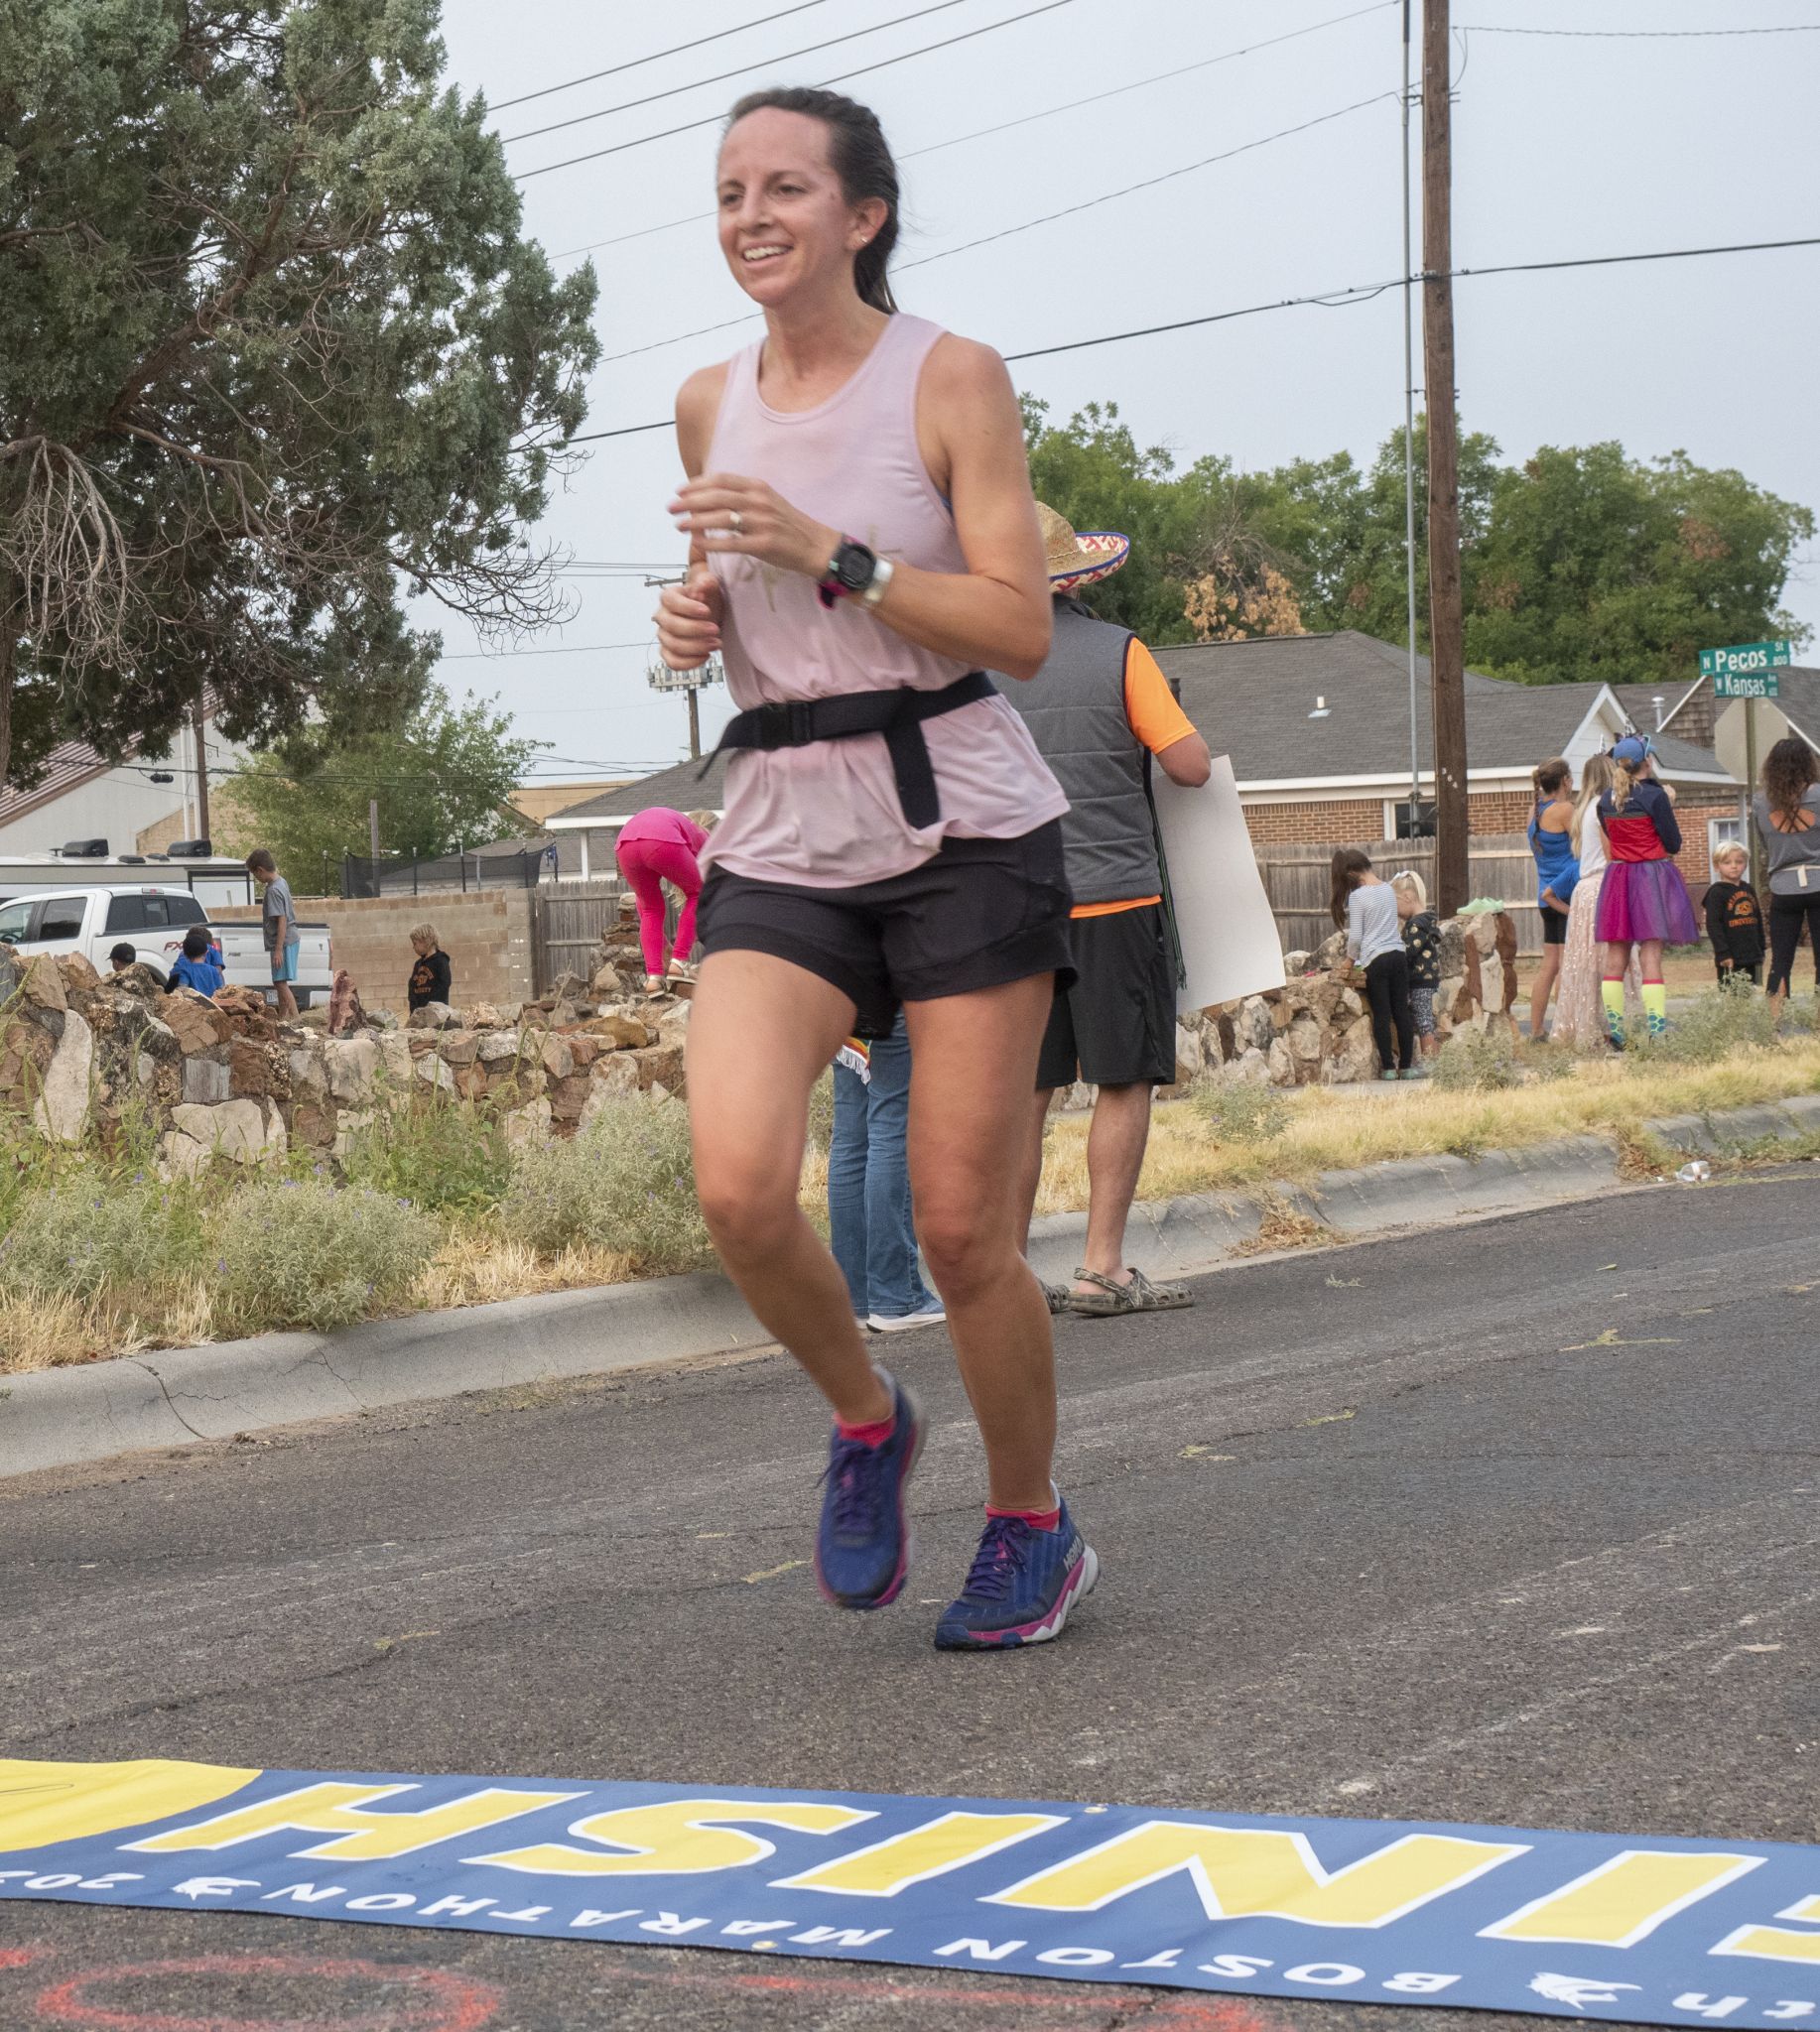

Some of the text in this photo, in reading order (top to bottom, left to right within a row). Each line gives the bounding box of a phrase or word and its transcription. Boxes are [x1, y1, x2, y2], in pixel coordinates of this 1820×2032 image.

[1703, 657, 1711, 670] N
[1715, 650, 1766, 672] Pecos
[1725, 674, 1765, 696] Kansas
[260, 1884, 893, 1947] MARATHON
[932, 1938, 1462, 1993] BOSTON
